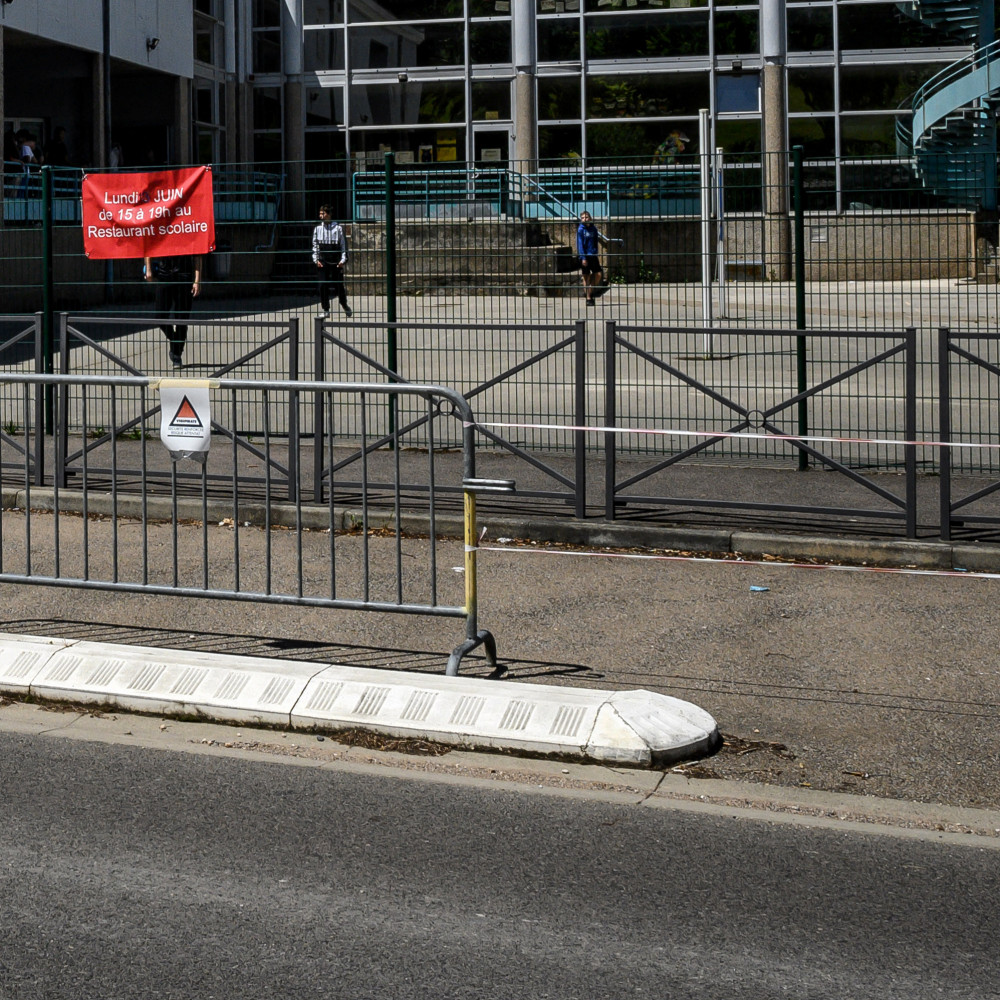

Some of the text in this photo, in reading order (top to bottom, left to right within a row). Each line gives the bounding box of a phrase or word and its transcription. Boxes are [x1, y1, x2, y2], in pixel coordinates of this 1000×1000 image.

[104, 192, 138, 204] Lundi
[154, 188, 184, 202] JUIN
[98, 206, 191, 221] de 15 à 19h au
[88, 220, 208, 238] Restaurant scolaire
